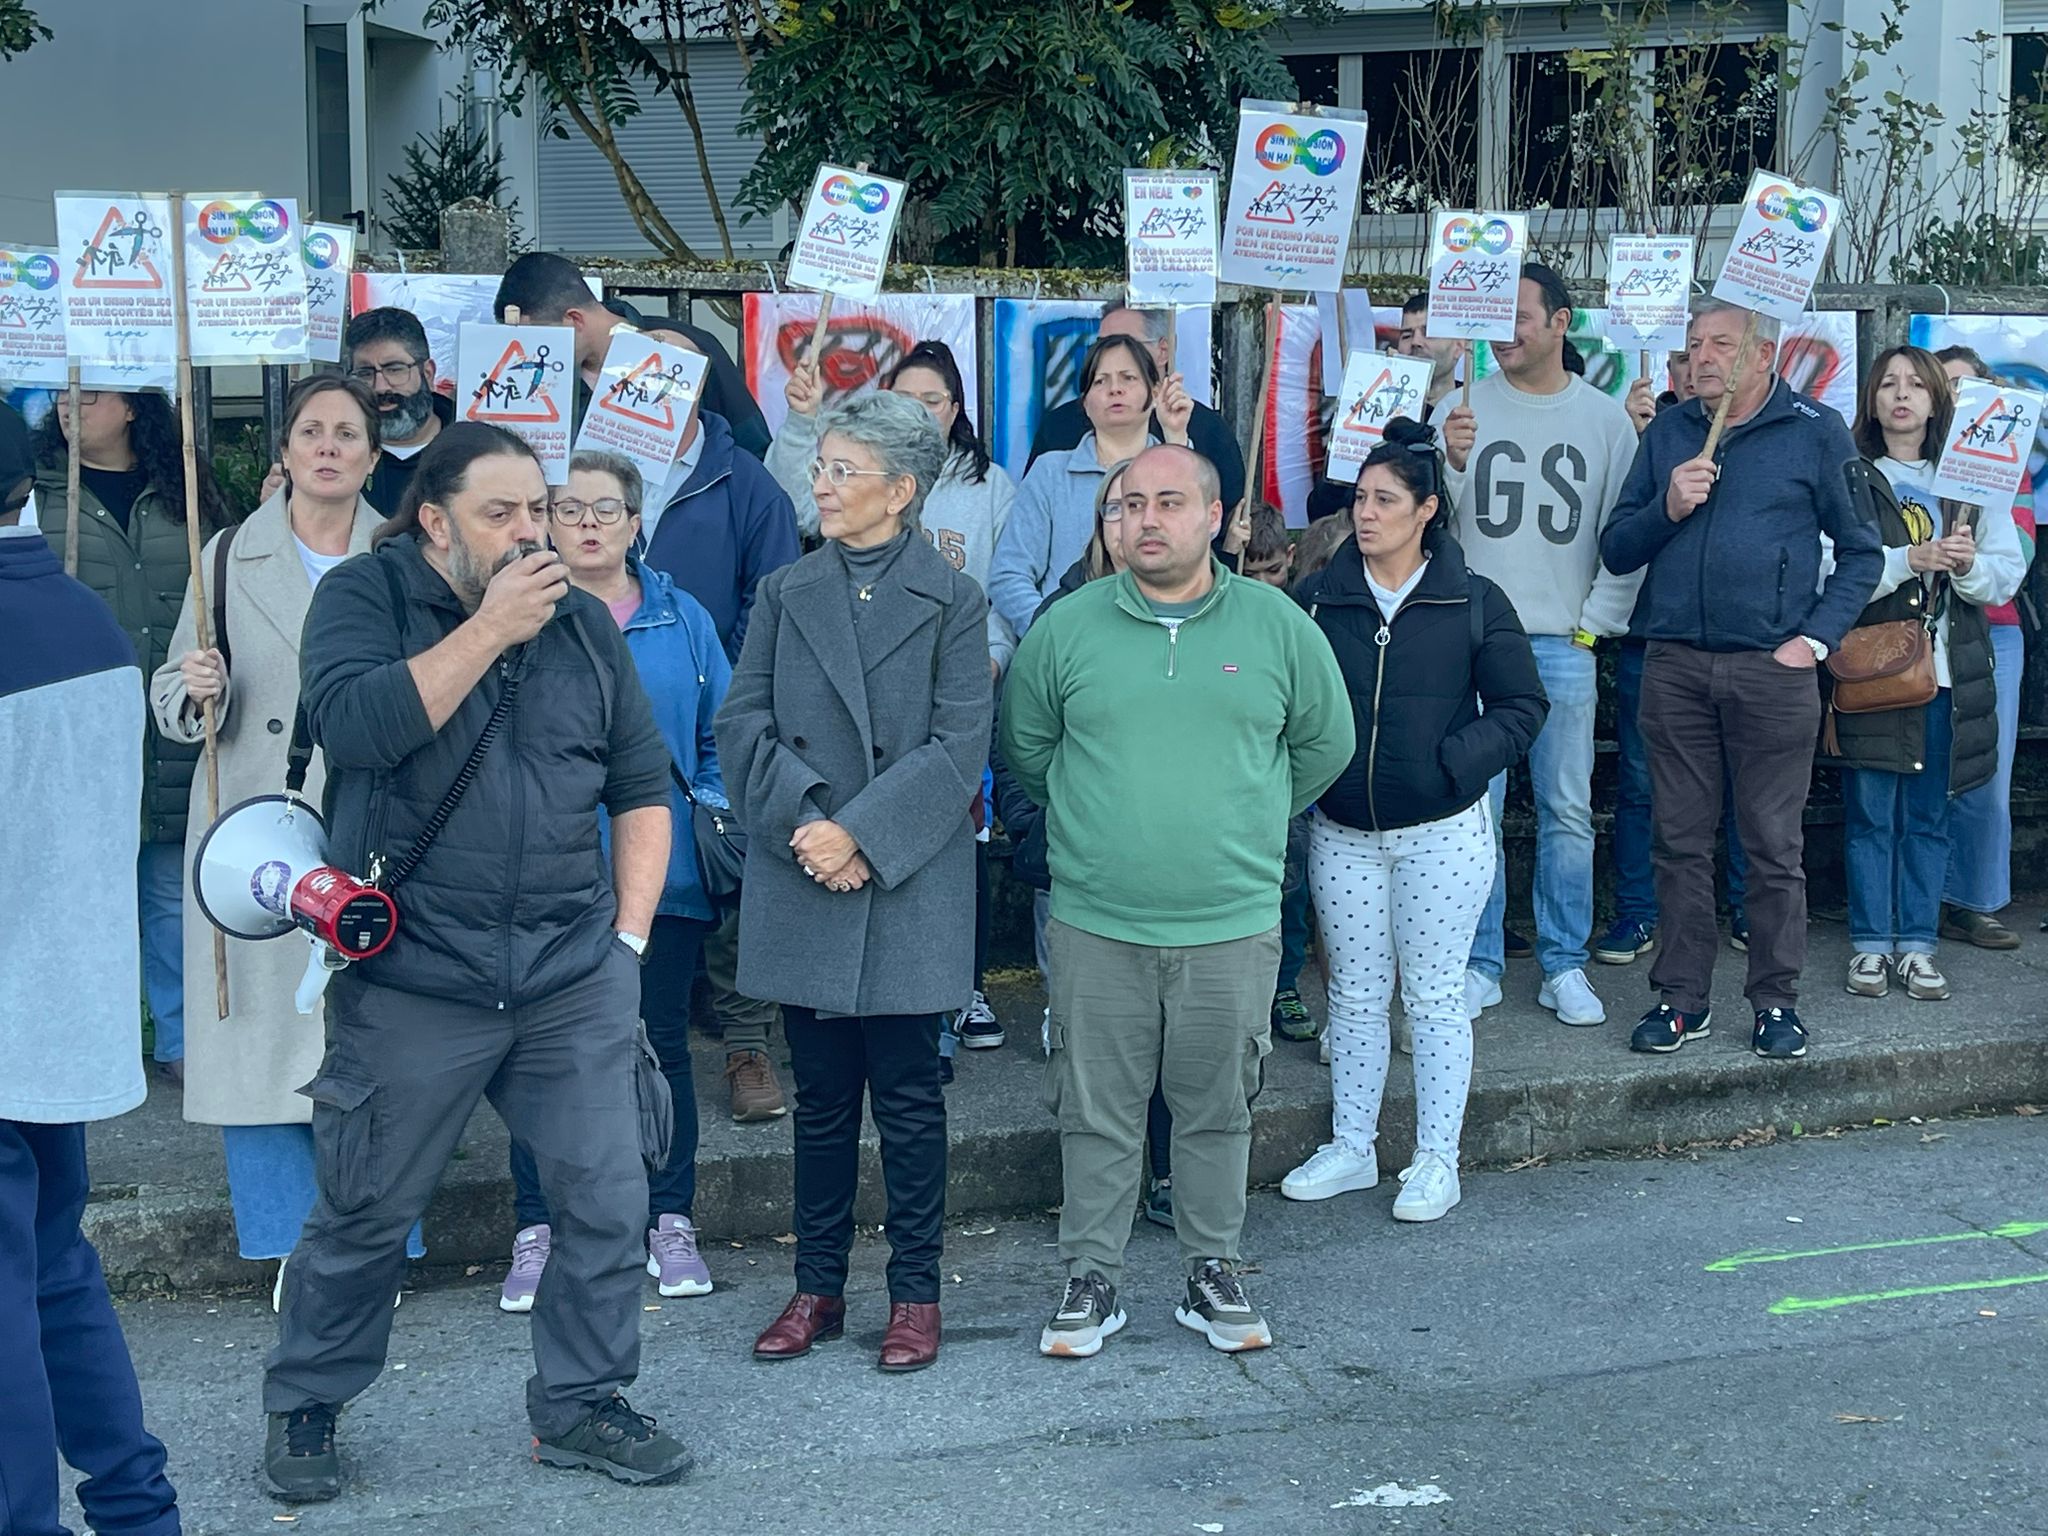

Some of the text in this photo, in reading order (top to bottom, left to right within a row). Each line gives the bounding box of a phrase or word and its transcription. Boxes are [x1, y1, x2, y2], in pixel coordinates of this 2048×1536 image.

[1270, 134, 1285, 146] SIN
[1276, 152, 1292, 164] HAI
[1134, 186, 1173, 200] EN NEAE
[211, 209, 226, 220] SIN
[220, 226, 237, 237] HAI
[1236, 225, 1339, 245] POR UN ENSINO PÚBLICO
[801, 241, 814, 251] POR
[1133, 247, 1149, 256] POR
[1172, 247, 1213, 256] EDUCACIÓN
[1234, 238, 1337, 256] SEN RECORTES NA
[817, 254, 862, 270] RECORTES
[1161, 256, 1213, 264] INCLUSIVA
[1232, 248, 1275, 260] ATENCIÓN
[1284, 254, 1335, 265] DIVERSIDADE
[1728, 256, 1743, 267] POR
[1144, 264, 1158, 272] DE
[1161, 264, 1213, 272] CALIDADE
[1745, 271, 1792, 292] RECORTES
[68, 296, 172, 307] POR UN ENSINO PÚBLICO
[196, 295, 301, 308] POR UN ENSINO PÚBLICO
[70, 307, 172, 317] SEN RECORTES NA
[197, 307, 301, 318] SEN RECORTES NA
[70, 318, 113, 326] ATENCIÓN
[197, 318, 239, 327] ATENCIÓN
[529, 429, 566, 440] PÚBLICO
[586, 422, 606, 434] SEN
[607, 428, 656, 451] RECORTES
[589, 413, 604, 424] POR
[644, 433, 676, 449] PÚBLICO
[550, 442, 566, 450] NA
